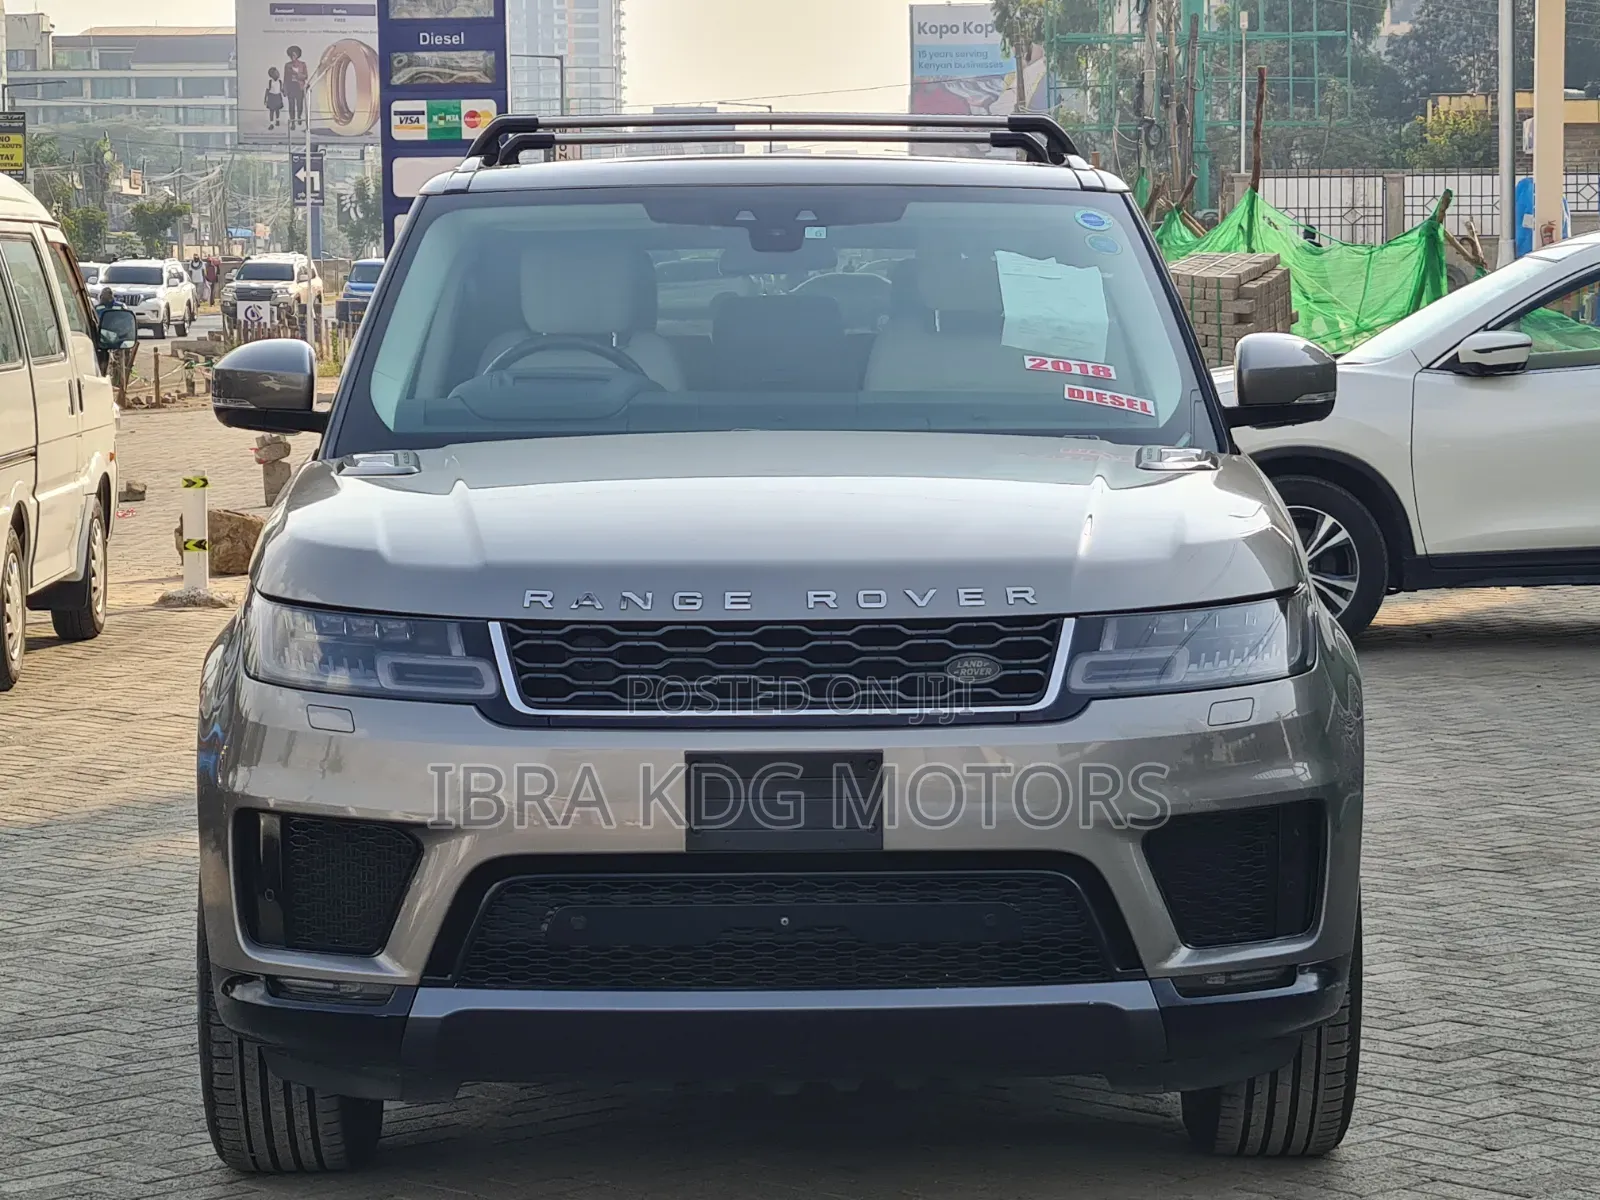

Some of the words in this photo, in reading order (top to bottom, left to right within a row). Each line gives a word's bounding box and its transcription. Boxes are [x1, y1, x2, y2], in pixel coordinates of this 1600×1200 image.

[917, 21, 959, 39] Kopo
[962, 21, 996, 38] Kop
[419, 31, 465, 45] Diesel
[917, 50, 927, 58] 15
[928, 51, 953, 60] years
[955, 49, 988, 60] serving
[918, 61, 953, 71] Kenyan
[954, 61, 1004, 69] businesses
[399, 116, 420, 124] VISA
[1027, 357, 1113, 379] 2018
[1067, 386, 1152, 414] DIESEL
[522, 589, 753, 611] RANGE
[806, 586, 1038, 609] ROVER
[957, 660, 984, 669] LAND
[959, 667, 993, 676] ROVER
